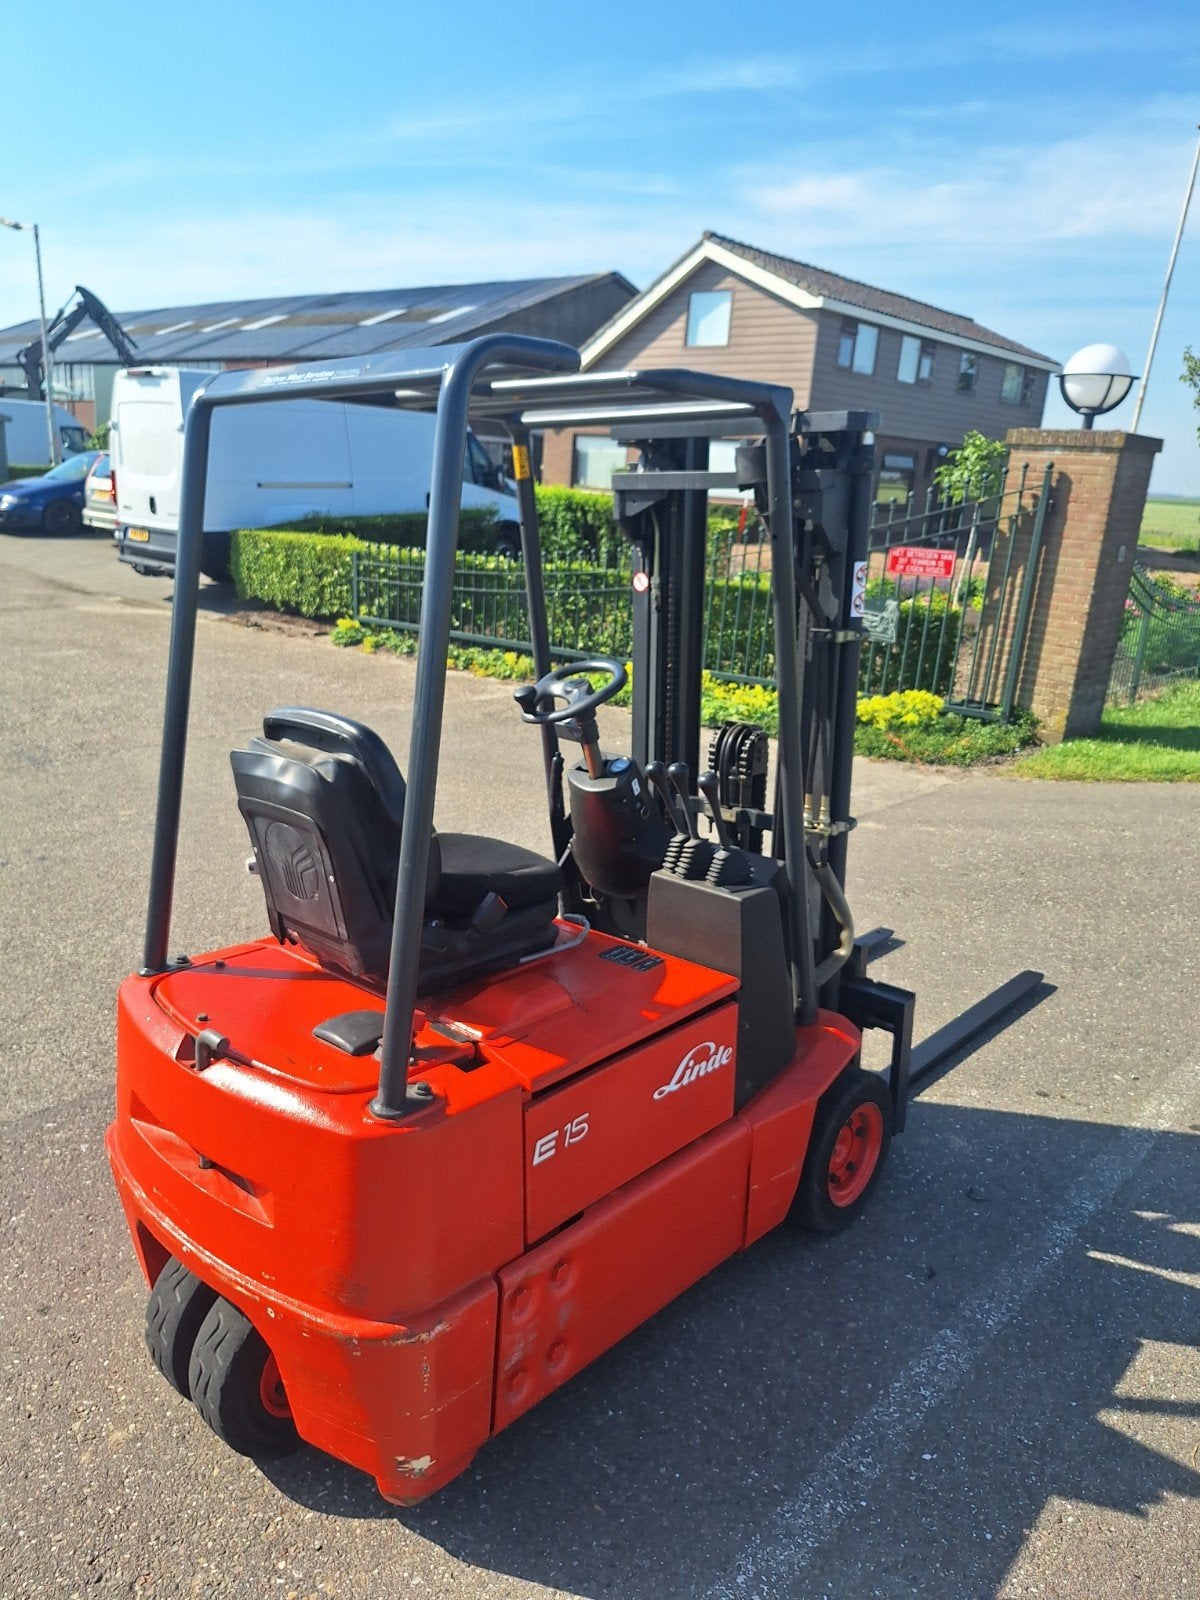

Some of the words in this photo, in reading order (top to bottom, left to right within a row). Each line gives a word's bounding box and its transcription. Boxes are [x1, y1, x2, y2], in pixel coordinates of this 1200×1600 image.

[653, 1041, 733, 1100] Linde
[533, 1130, 559, 1166] E
[563, 1112, 590, 1147] 15
